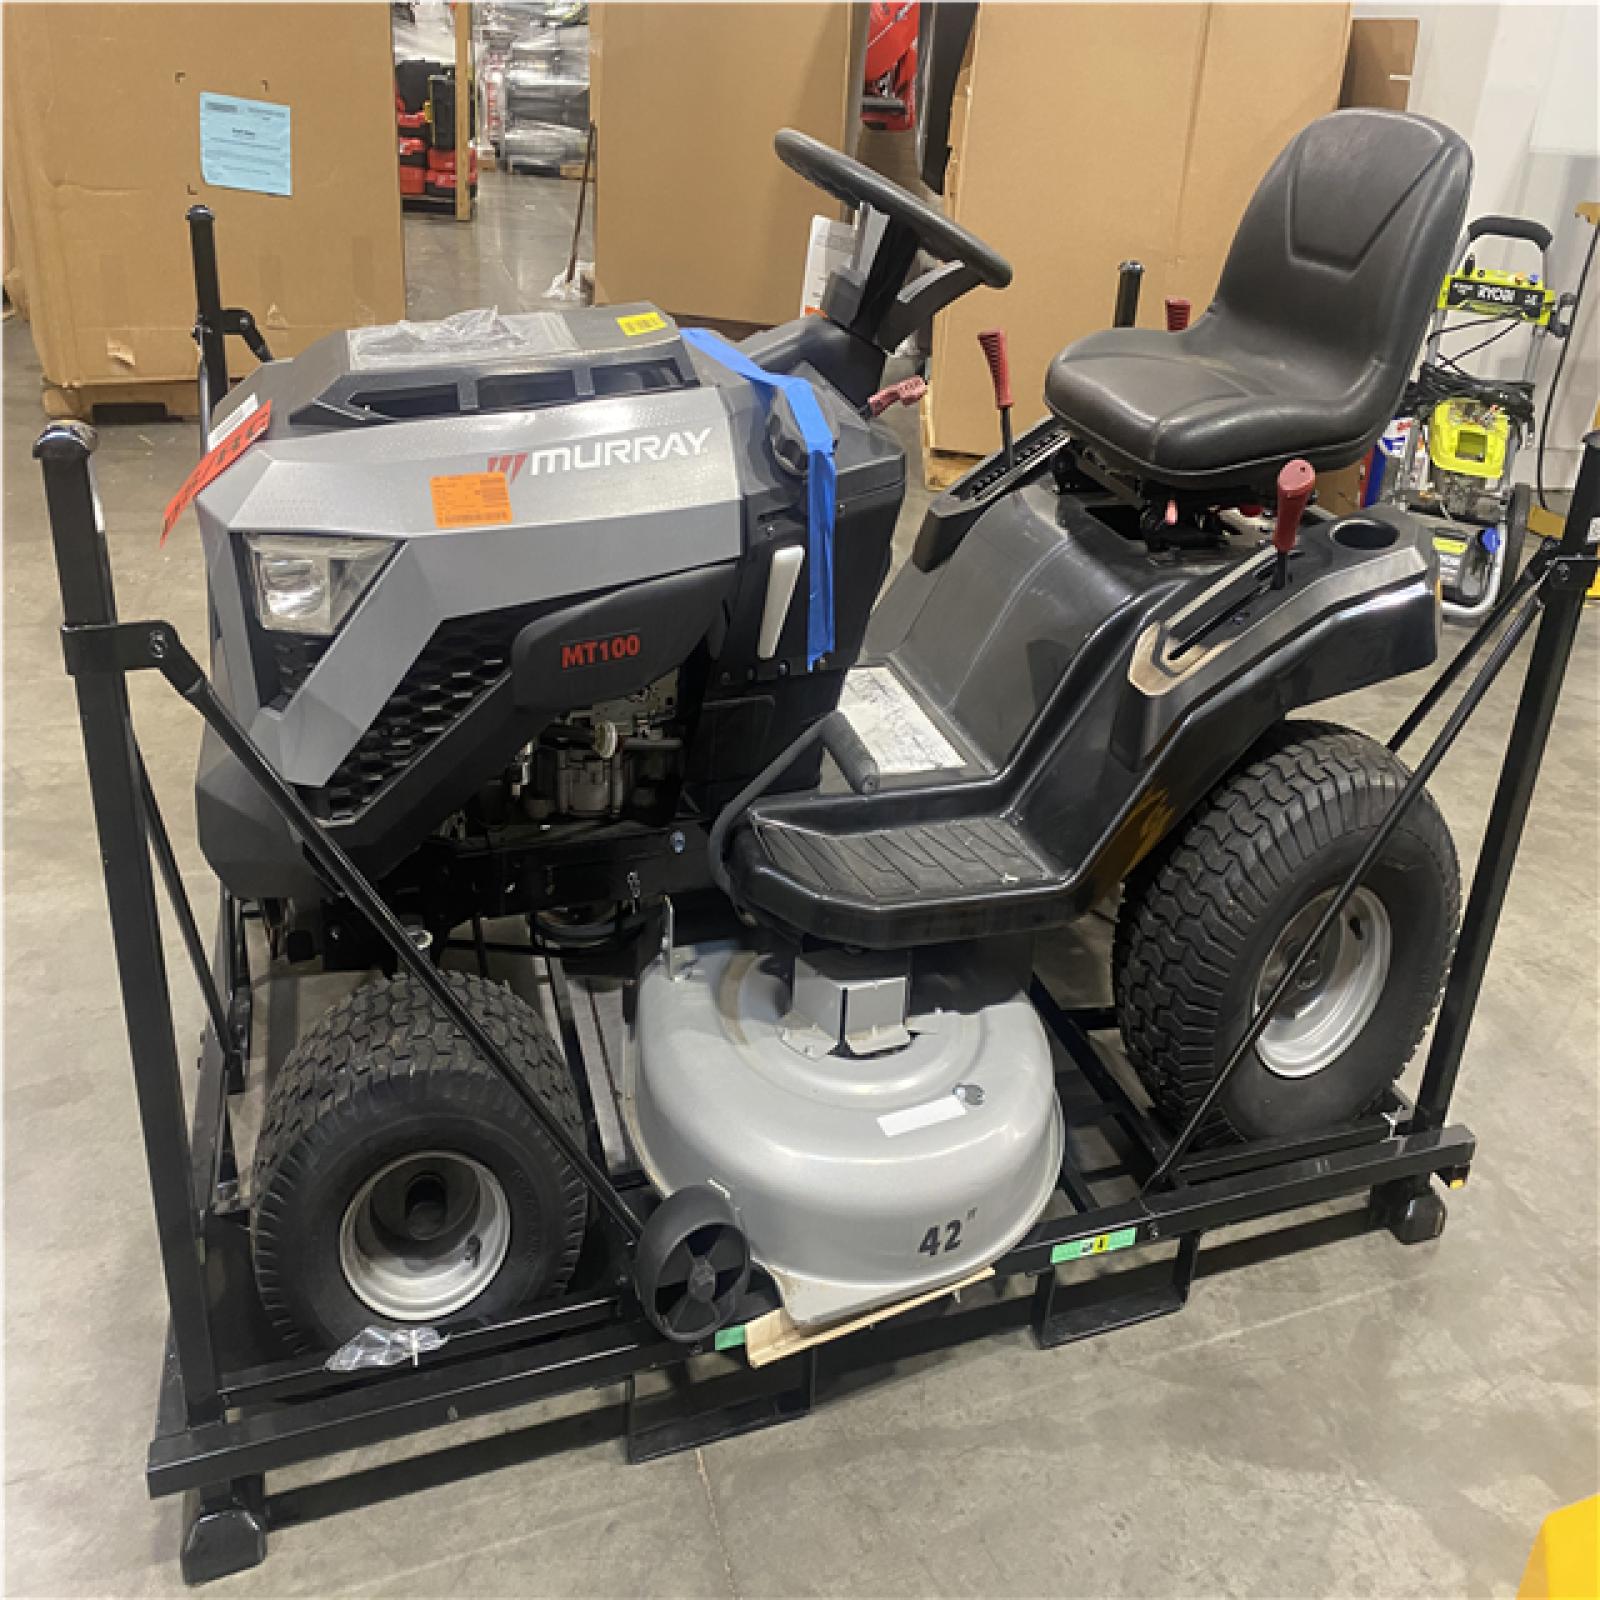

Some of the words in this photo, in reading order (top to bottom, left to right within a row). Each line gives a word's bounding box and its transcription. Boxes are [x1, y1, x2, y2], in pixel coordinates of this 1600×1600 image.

[1476, 284, 1515, 303] RYOBI
[530, 427, 712, 476] MURRAY
[561, 634, 641, 670] MT100
